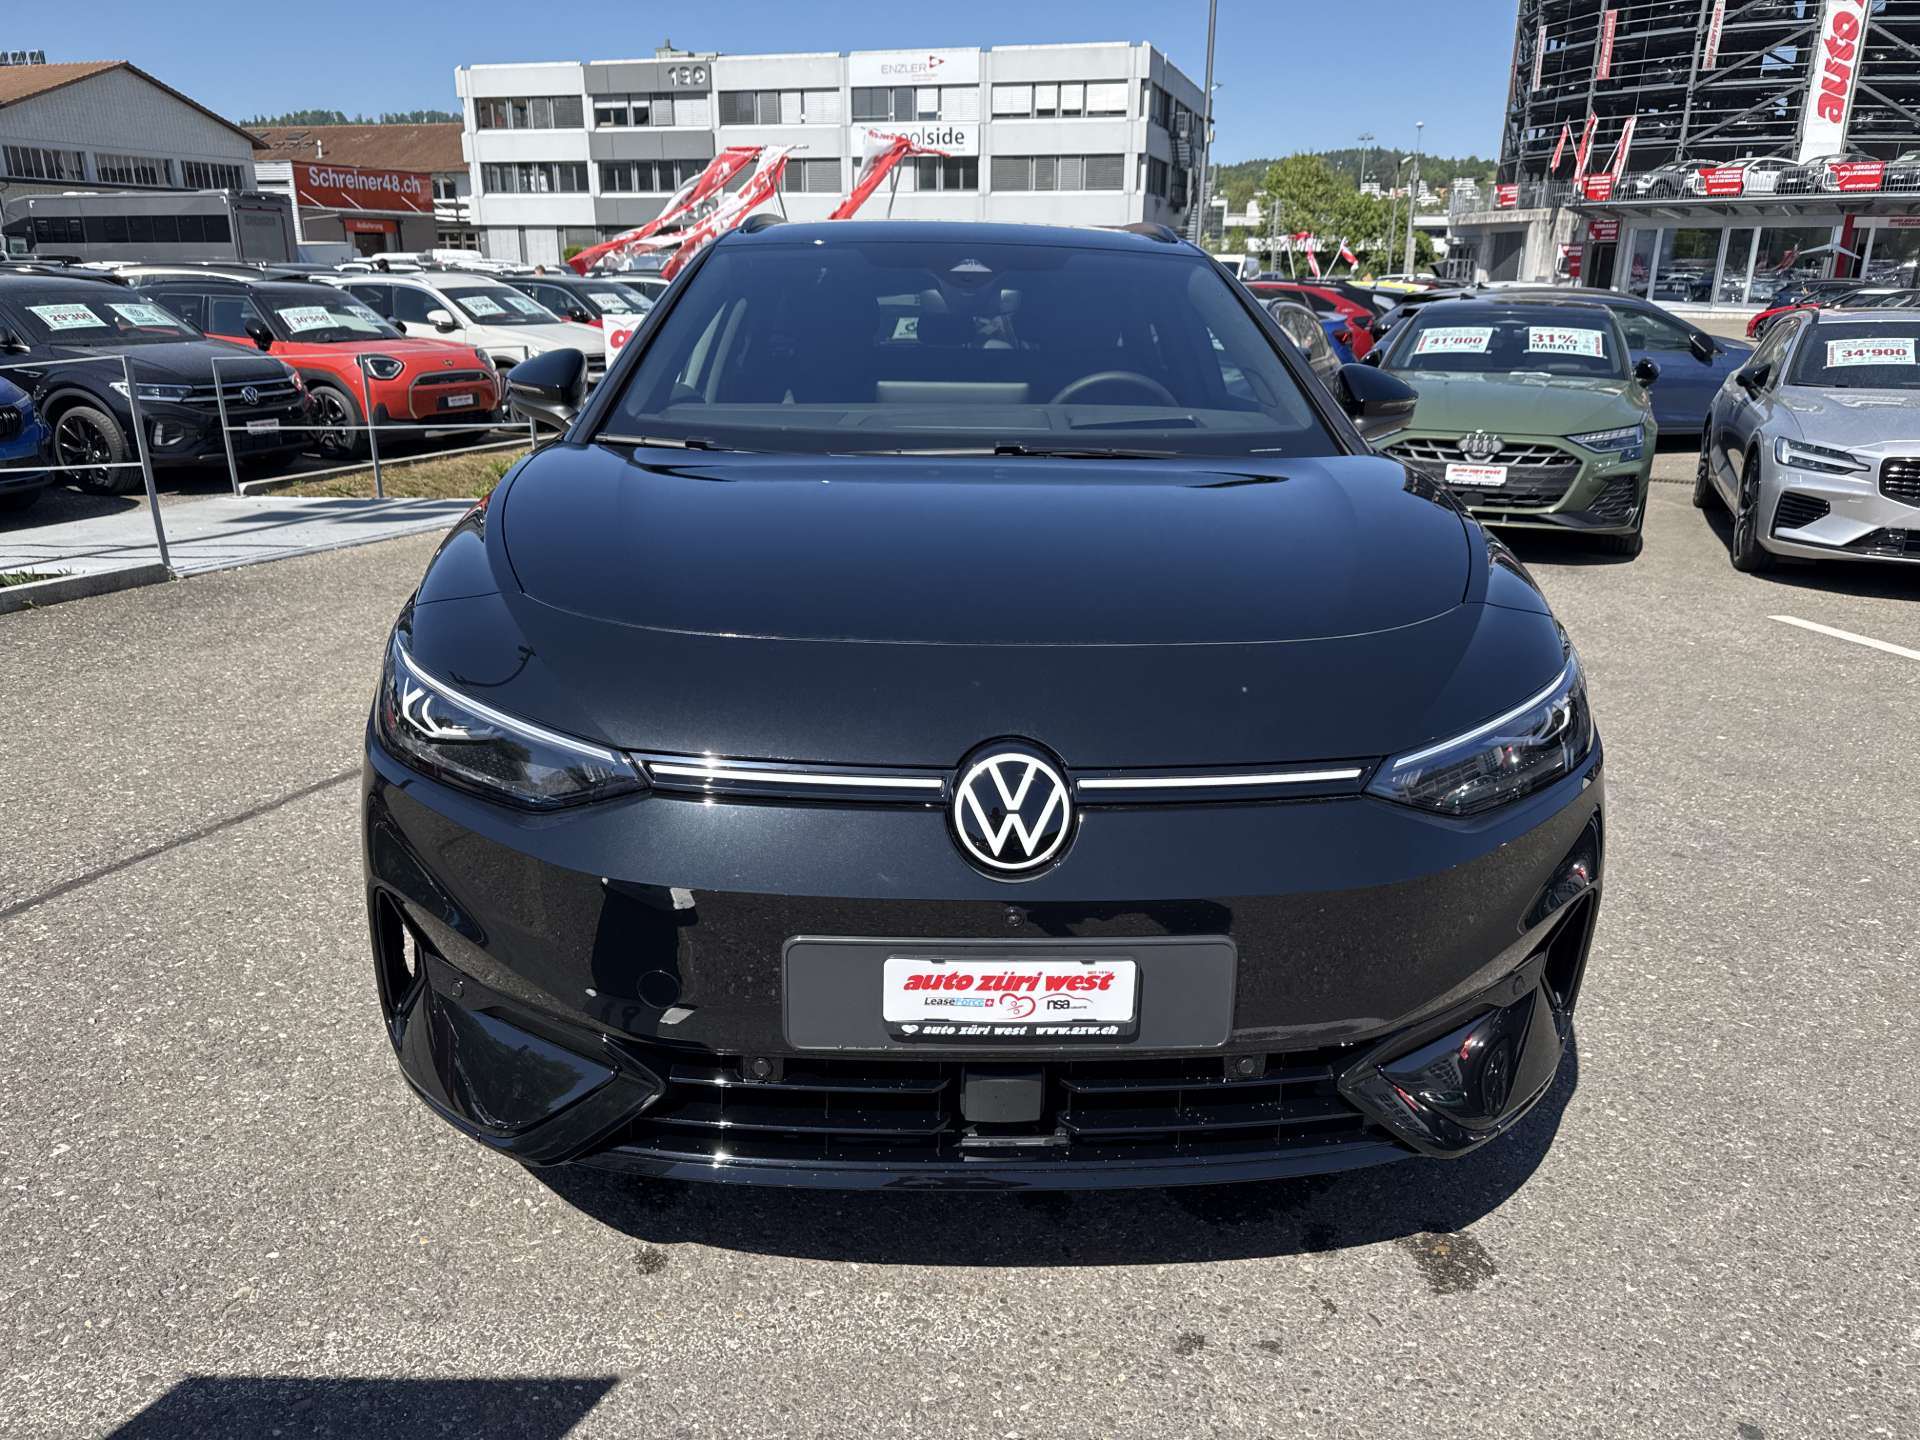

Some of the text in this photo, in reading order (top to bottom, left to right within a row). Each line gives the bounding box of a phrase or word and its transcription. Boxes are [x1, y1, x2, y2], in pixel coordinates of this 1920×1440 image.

[881, 63, 928, 75] ENZLER
[1817, 11, 1860, 124] auto
[308, 165, 421, 194] Schreiner48.ch
[1531, 333, 1578, 345] 31%
[1532, 343, 1578, 351] RABATT
[1841, 348, 1907, 358] 34'900
[903, 971, 1115, 992] auto züri west
[1047, 999, 1071, 1010] nsa
[922, 1025, 956, 1035] auto
[958, 1024, 991, 1035] züri
[994, 1025, 1028, 1035] west
